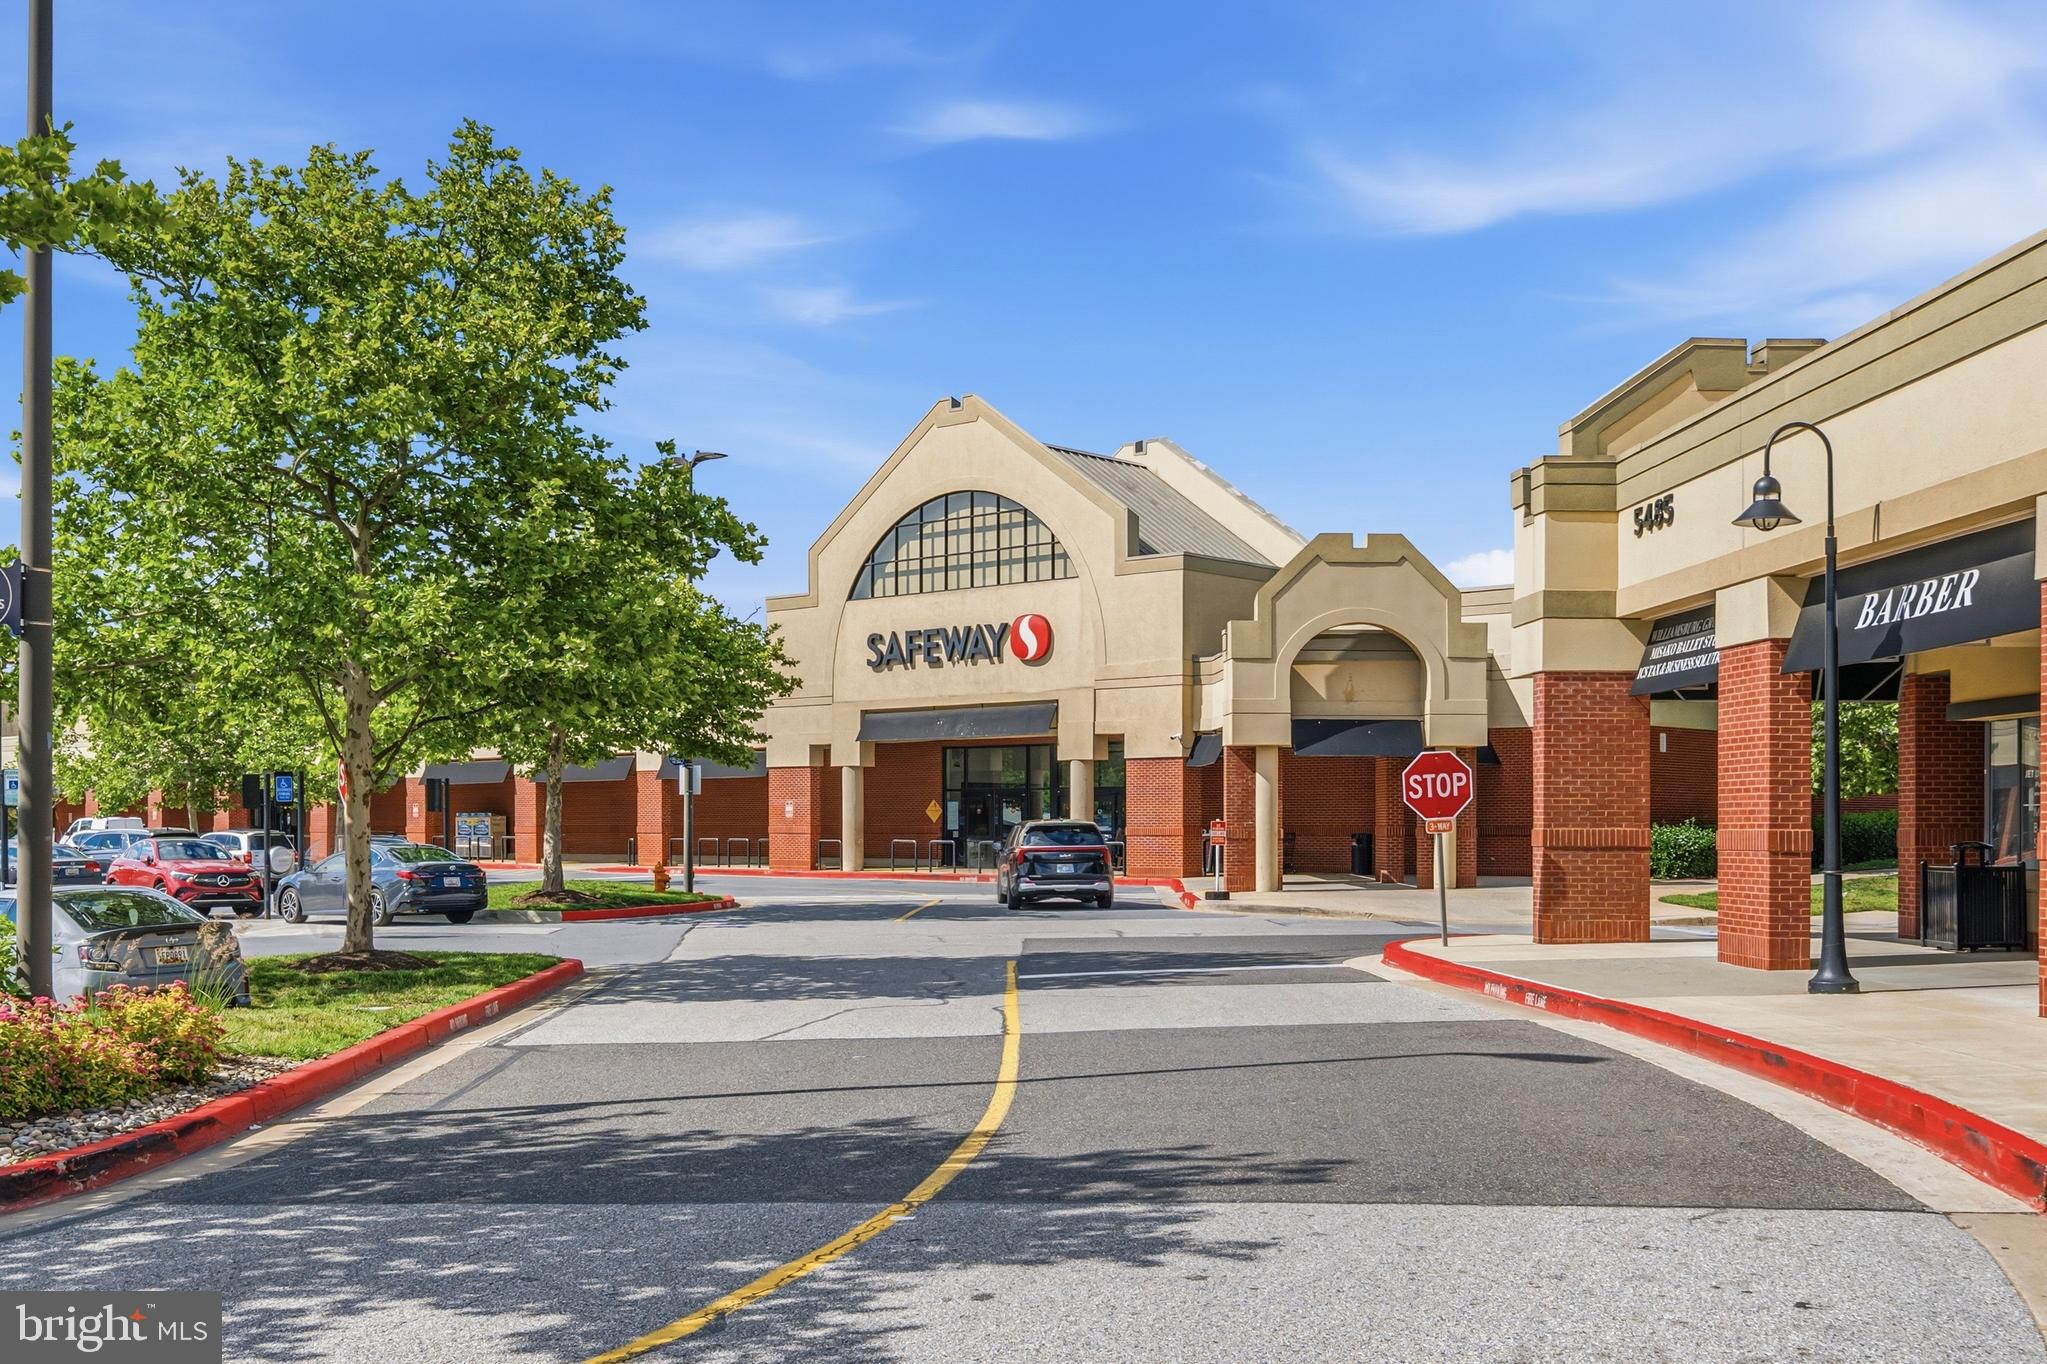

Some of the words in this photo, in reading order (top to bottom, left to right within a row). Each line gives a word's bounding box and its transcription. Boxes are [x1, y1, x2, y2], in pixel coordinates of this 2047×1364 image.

[1633, 493, 1675, 539] 5485
[1854, 569, 1980, 630] BARBER
[866, 622, 1009, 668] SAFEWAY
[1675, 636, 1705, 655] BALLET
[1408, 772, 1467, 799] STOP
[1429, 822, 1451, 832] 3-WAY
